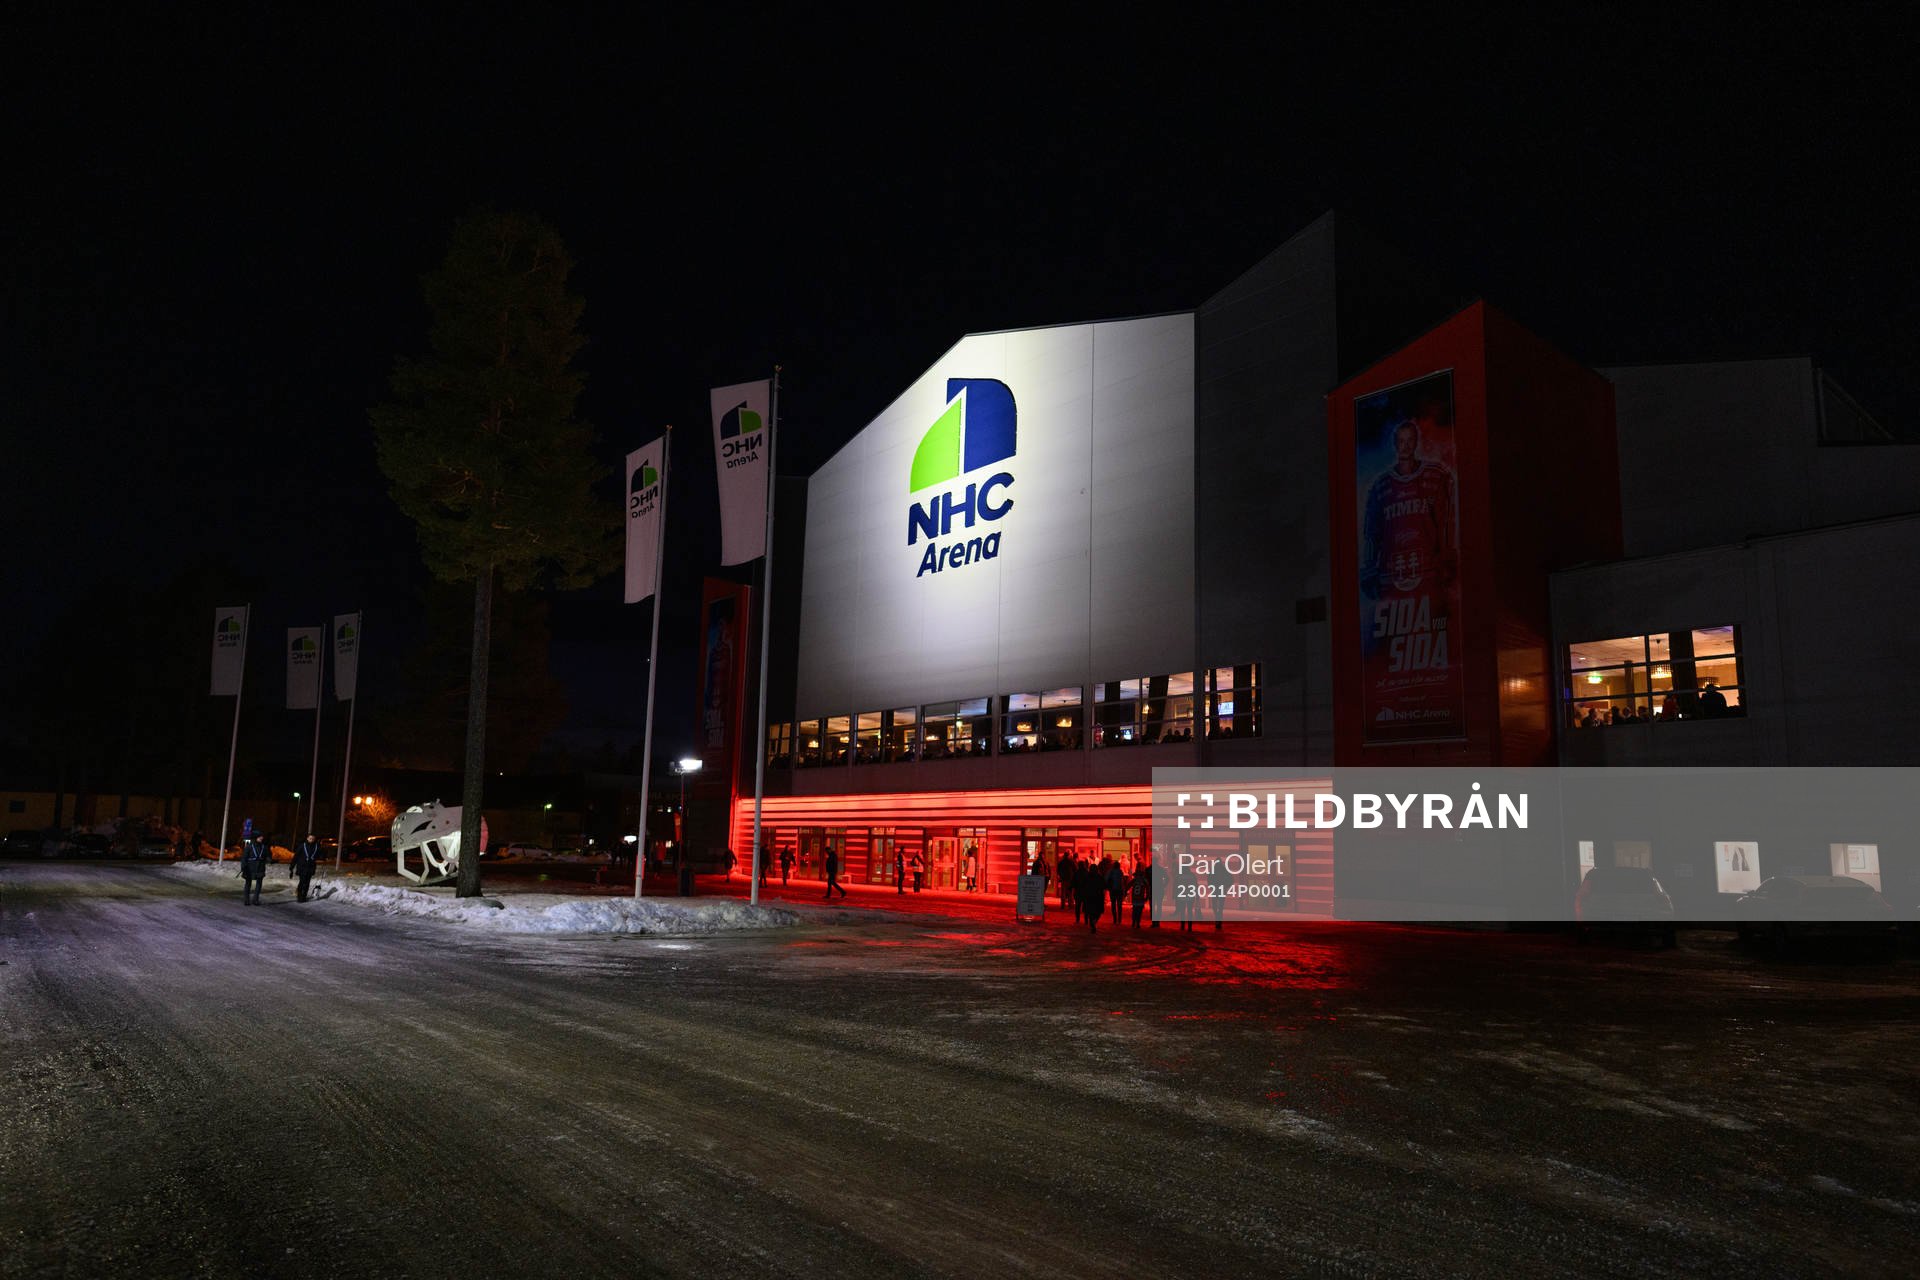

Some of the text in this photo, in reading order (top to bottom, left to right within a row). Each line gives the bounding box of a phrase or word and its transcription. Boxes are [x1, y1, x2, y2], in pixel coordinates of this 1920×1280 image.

[908, 472, 1015, 546] NHC
[916, 531, 1002, 578] Arena
[1373, 594, 1432, 639] SIDA
[1388, 630, 1449, 673] SIDA
